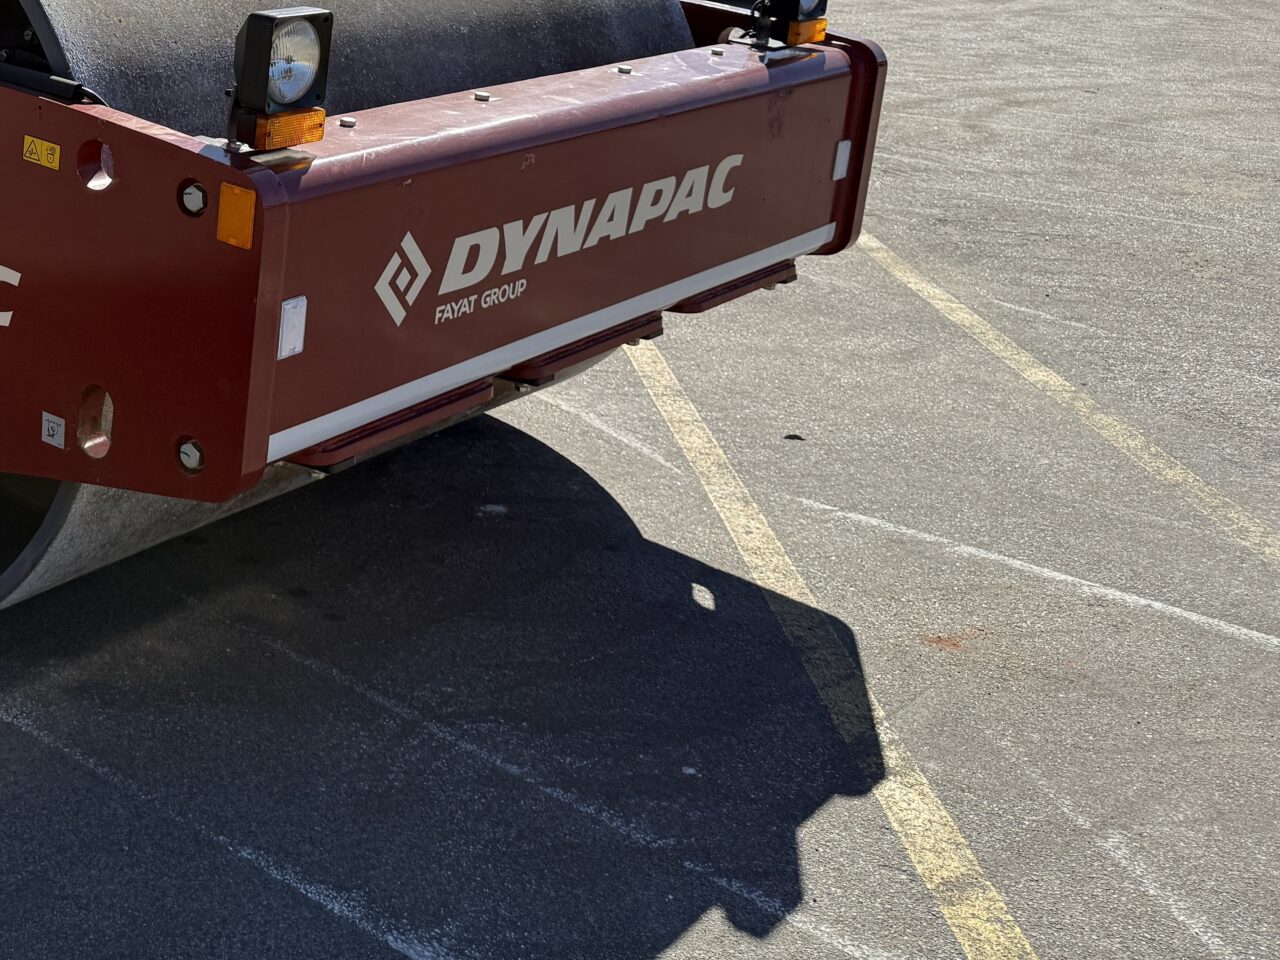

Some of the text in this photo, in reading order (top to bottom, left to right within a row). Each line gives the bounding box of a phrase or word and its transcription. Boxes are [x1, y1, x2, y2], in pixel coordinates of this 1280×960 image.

[437, 154, 744, 296] DYNAPAC
[434, 278, 527, 325] FAYAT GROUP
